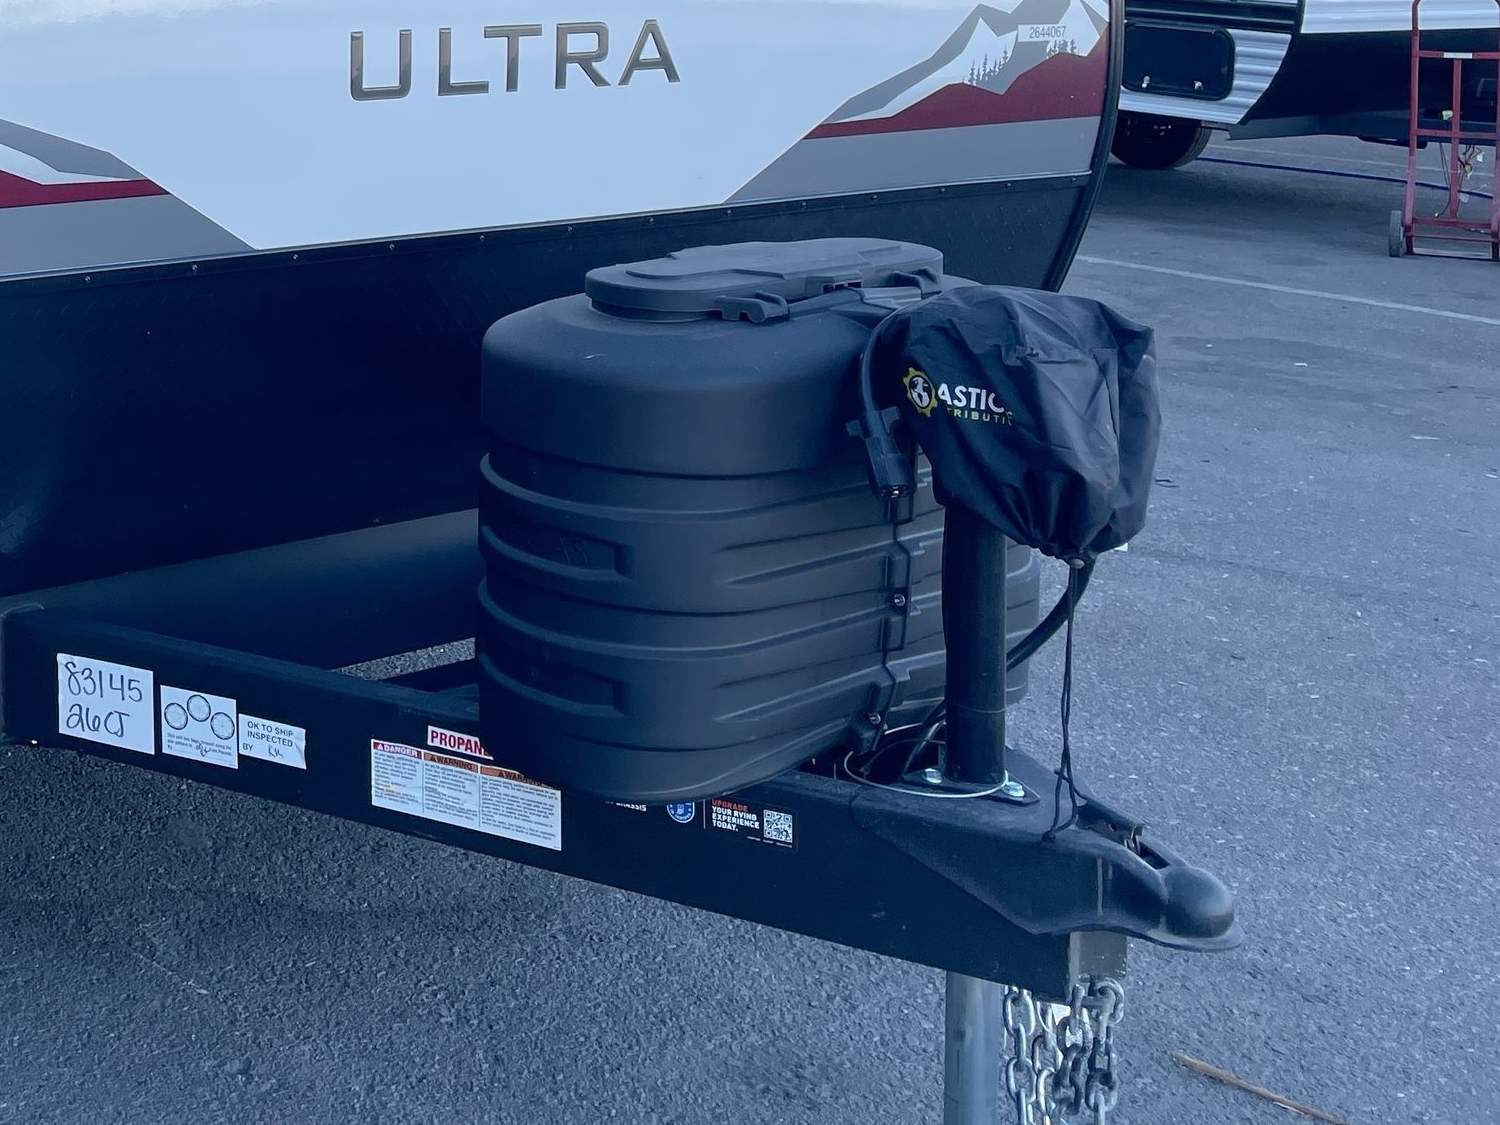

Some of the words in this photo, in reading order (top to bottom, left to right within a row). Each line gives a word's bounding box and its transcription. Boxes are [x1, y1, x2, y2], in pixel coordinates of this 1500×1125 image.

[1029, 25, 1067, 39] 2644067
[350, 18, 681, 102] ULTRA
[64, 661, 143, 703] 83145
[247, 720, 260, 730] OK
[261, 723, 273, 733] TO
[274, 726, 294, 737] SHIP
[242, 742, 254, 752] BY
[247, 730, 294, 748] INSPECTED
[383, 744, 418, 759] DANGER
[436, 755, 473, 771] WARNING
[711, 798, 749, 812] UPGRADE
[711, 805, 733, 816] YOUR
[733, 810, 758, 822] RVING
[711, 812, 760, 830] EXPERIENCE
[711, 819, 739, 832] TODAY.
